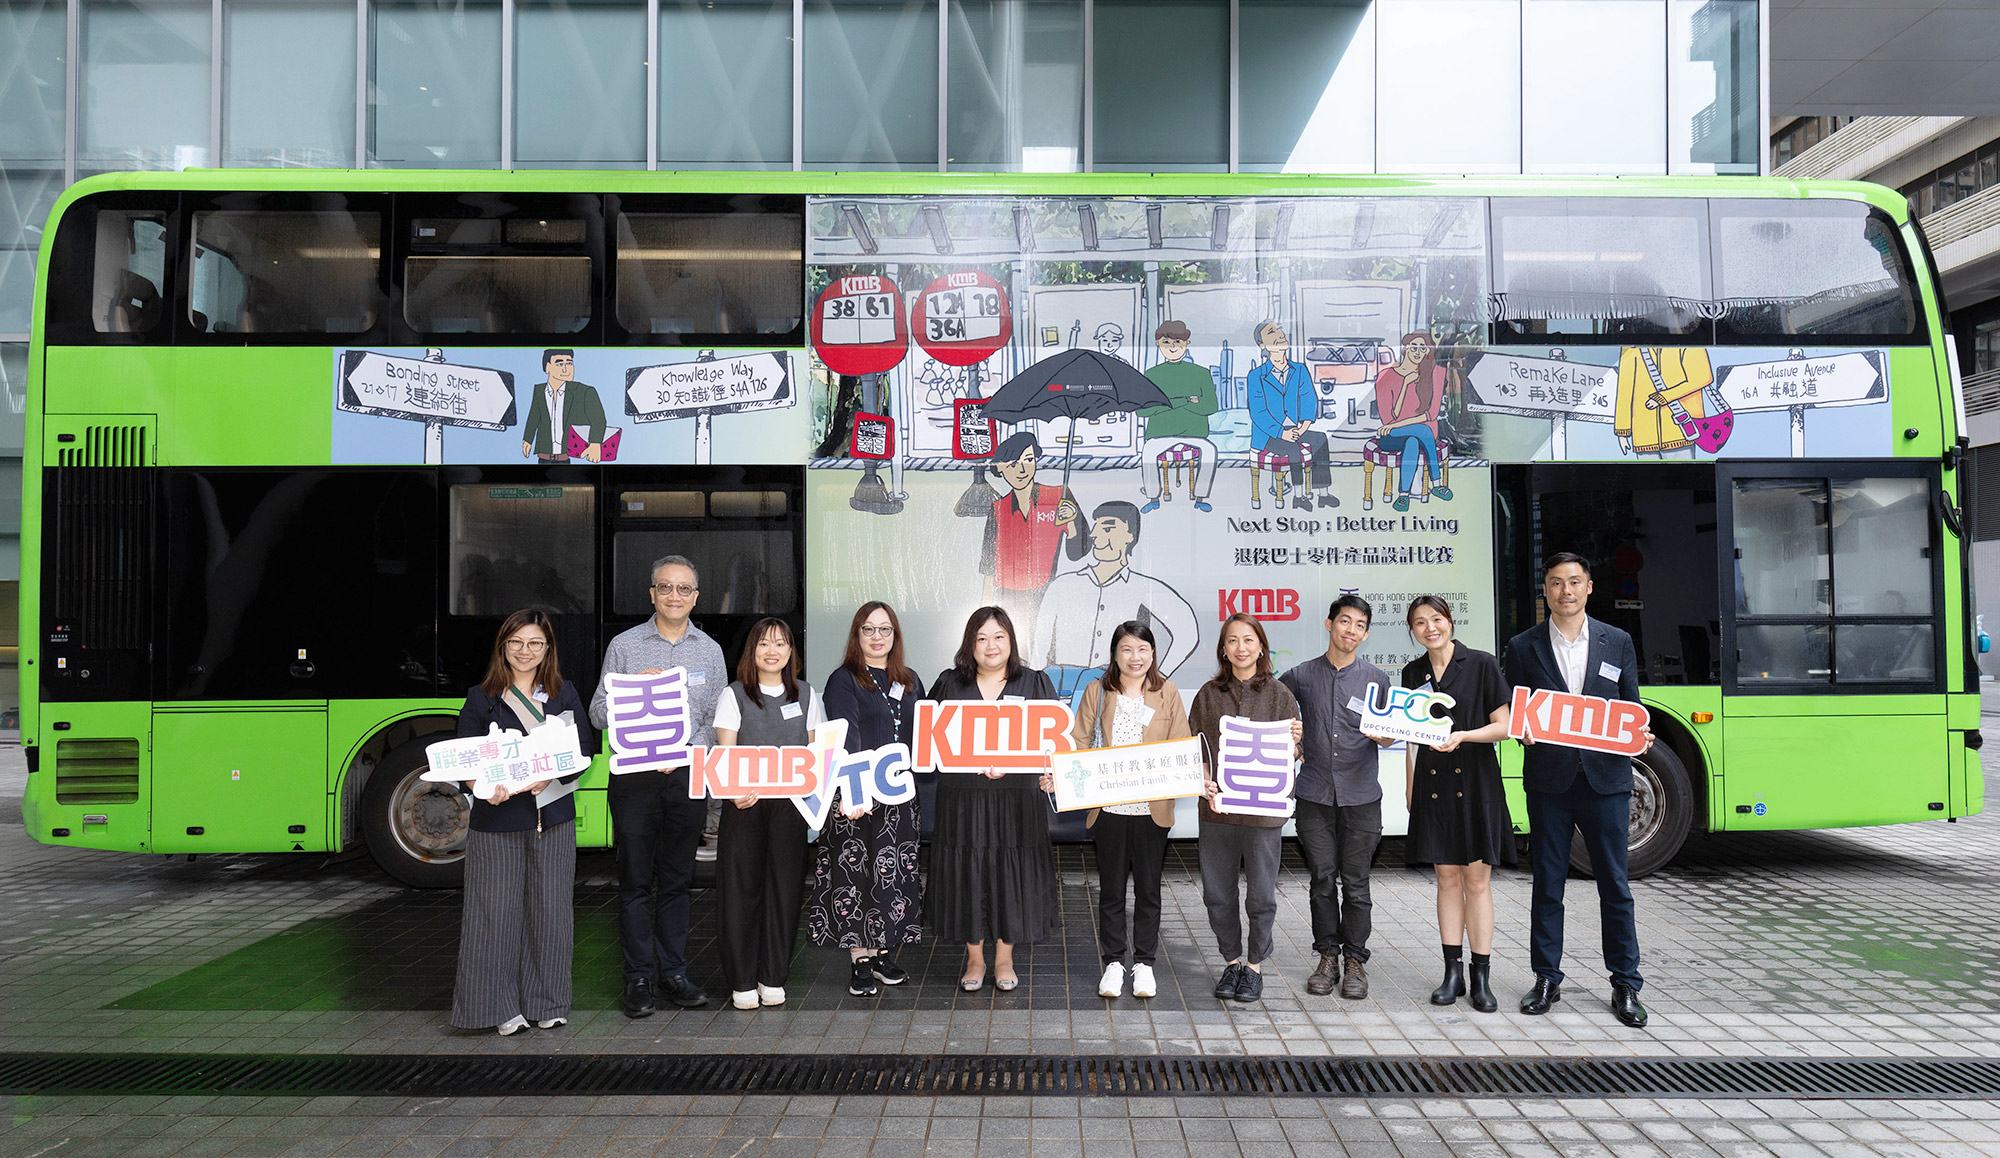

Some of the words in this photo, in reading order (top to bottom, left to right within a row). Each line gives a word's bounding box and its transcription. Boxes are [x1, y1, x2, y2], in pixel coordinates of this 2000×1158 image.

[841, 276, 881, 295] KMB
[948, 272, 979, 287] KMB
[832, 300, 856, 318] 38
[866, 297, 890, 317] 61
[930, 318, 965, 341] 36A
[386, 362, 439, 388] Bonding
[662, 366, 725, 387] Knowledge
[731, 360, 753, 379] Way
[1572, 368, 1605, 388] Lane
[1757, 365, 1799, 380] Inclusive
[1804, 362, 1836, 376] Avenue
[404, 384, 468, 415] 連結街
[656, 390, 671, 405] 30
[1528, 385, 1586, 407] 再造里
[1037, 510, 1055, 524] KMB
[1227, 516, 1272, 533] Next
[1276, 516, 1321, 536] Stop
[1336, 516, 1397, 533] Better
[1401, 516, 1459, 535] Living
[1234, 546, 1455, 567] 退役巴士零件產品設計比賽
[1218, 588, 1301, 622] KMB
[1510, 687, 1648, 754] KMB
[917, 704, 1071, 768] KMB
[1363, 722, 1411, 736] UPCYCLING
[1414, 731, 1447, 742] CENTRE
[432, 738, 523, 770] 職業專才
[483, 750, 576, 784] 連繫社區
[691, 747, 818, 796] KMB
[1099, 777, 1140, 791] Christian
